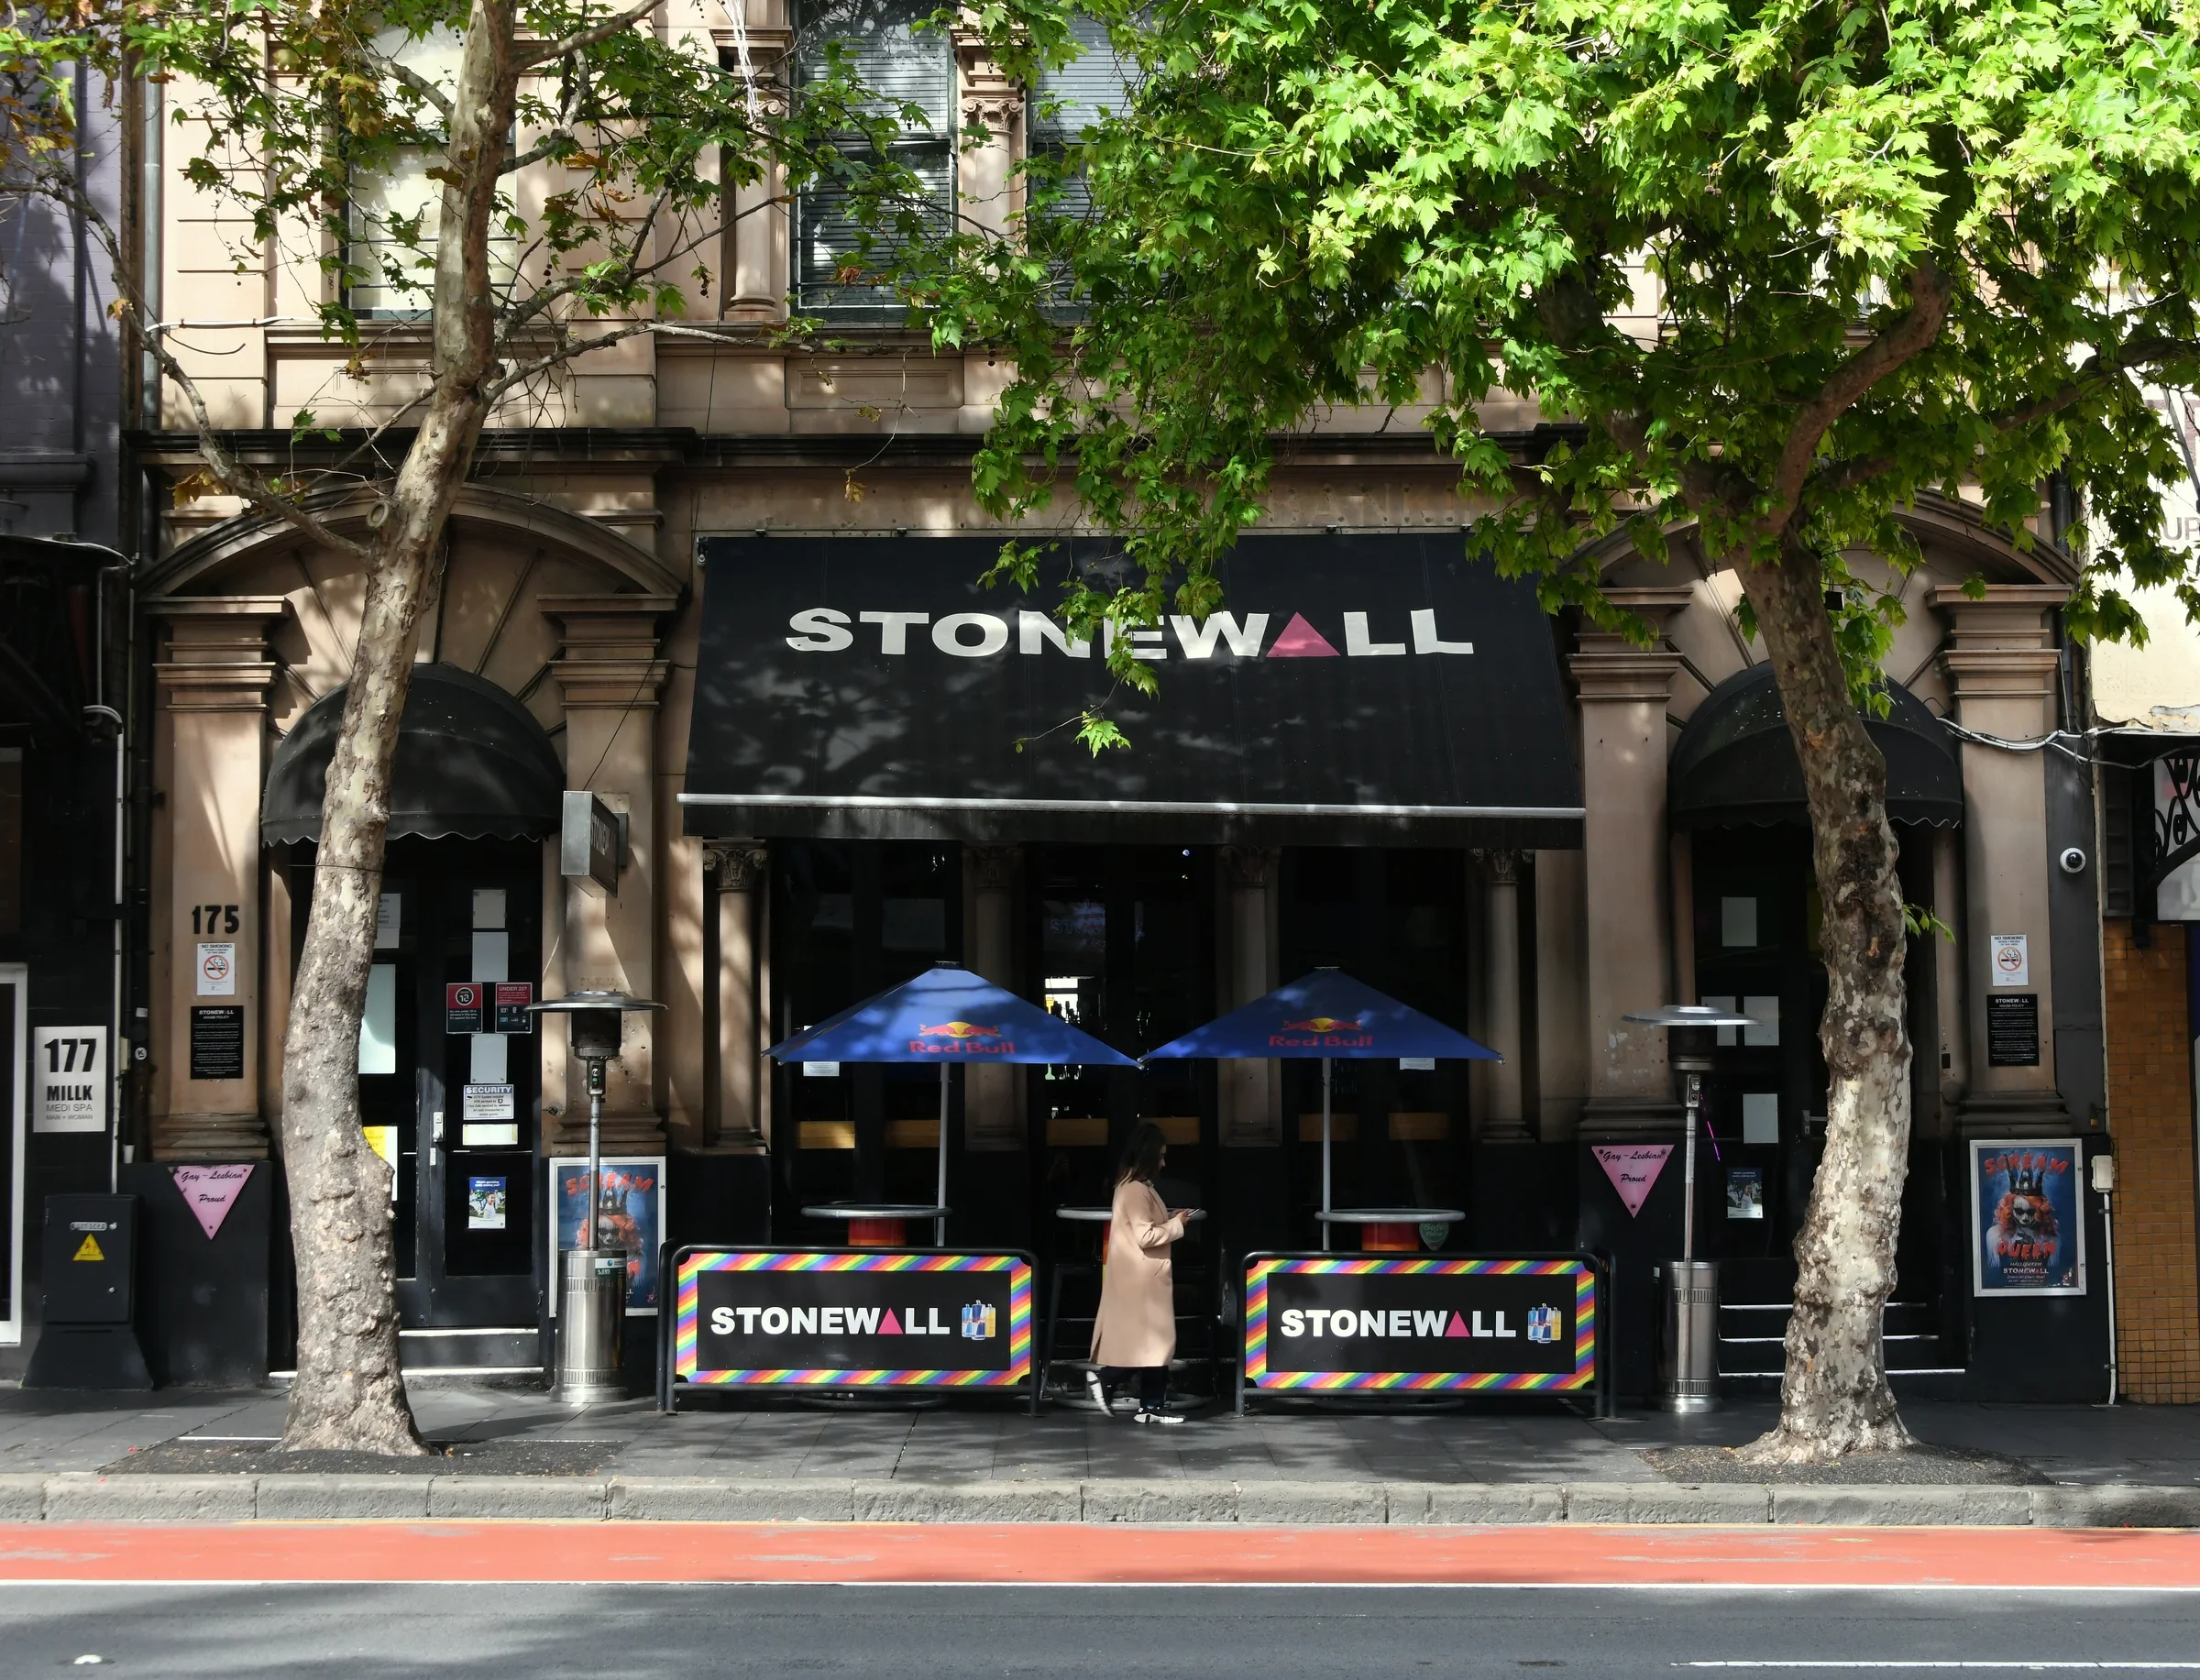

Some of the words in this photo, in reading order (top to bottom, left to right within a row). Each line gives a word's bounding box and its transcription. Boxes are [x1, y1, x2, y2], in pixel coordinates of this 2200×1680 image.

[786, 608, 1474, 659] STONEWALL
[192, 906, 240, 934] 175
[459, 994, 470, 1003] 18
[908, 1040, 961, 1053] Red
[965, 1041, 1016, 1054] Bull
[1269, 1035, 1319, 1047] Red
[1325, 1035, 1373, 1047] Bull
[44, 1038, 96, 1072] 177
[47, 1084, 93, 1101] MILLK
[46, 1104, 71, 1112] MEDI
[1602, 1151, 1622, 1163] Gay
[1630, 1150, 1662, 1159] Lesbian
[1984, 1153, 2070, 1176] SCREAM
[181, 1170, 200, 1183] Gay
[209, 1170, 243, 1180] Lesbian
[1620, 1173, 1647, 1182] Proud
[198, 1193, 226, 1203] Proud
[1996, 1240, 2056, 1259] QUEEN
[710, 1306, 951, 1334] STONEWALL
[1280, 1309, 1516, 1337] STONEWALL
